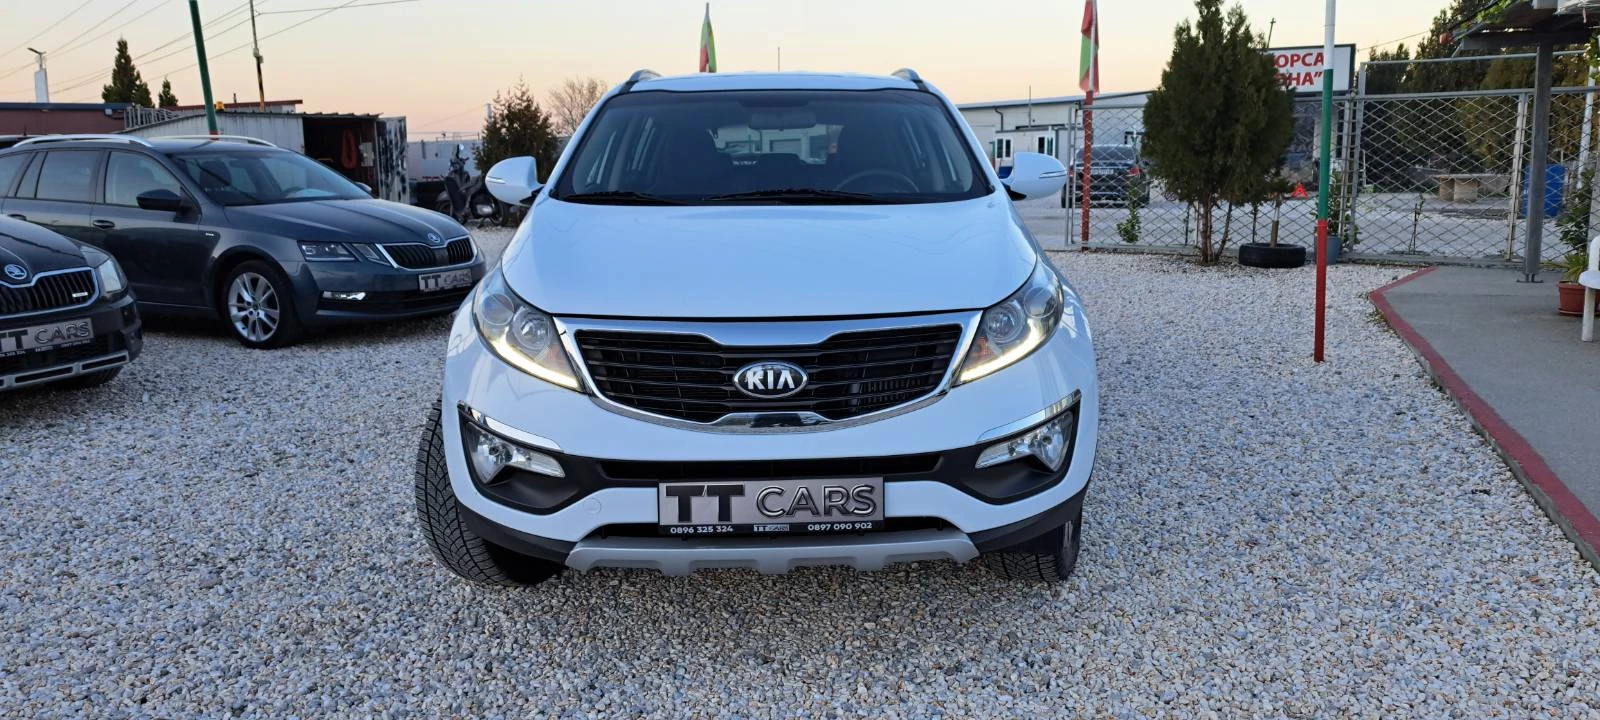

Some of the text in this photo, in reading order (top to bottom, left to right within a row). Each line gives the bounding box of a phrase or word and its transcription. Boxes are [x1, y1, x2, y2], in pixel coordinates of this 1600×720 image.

[1273, 52, 1324, 68] ОРСА
[34, 322, 89, 344] CARS
[744, 366, 796, 390] KIA
[665, 484, 877, 523] TT CARS
[670, 526, 694, 534] 0896
[716, 525, 734, 533] 324
[807, 522, 873, 531] 0897 090 902
